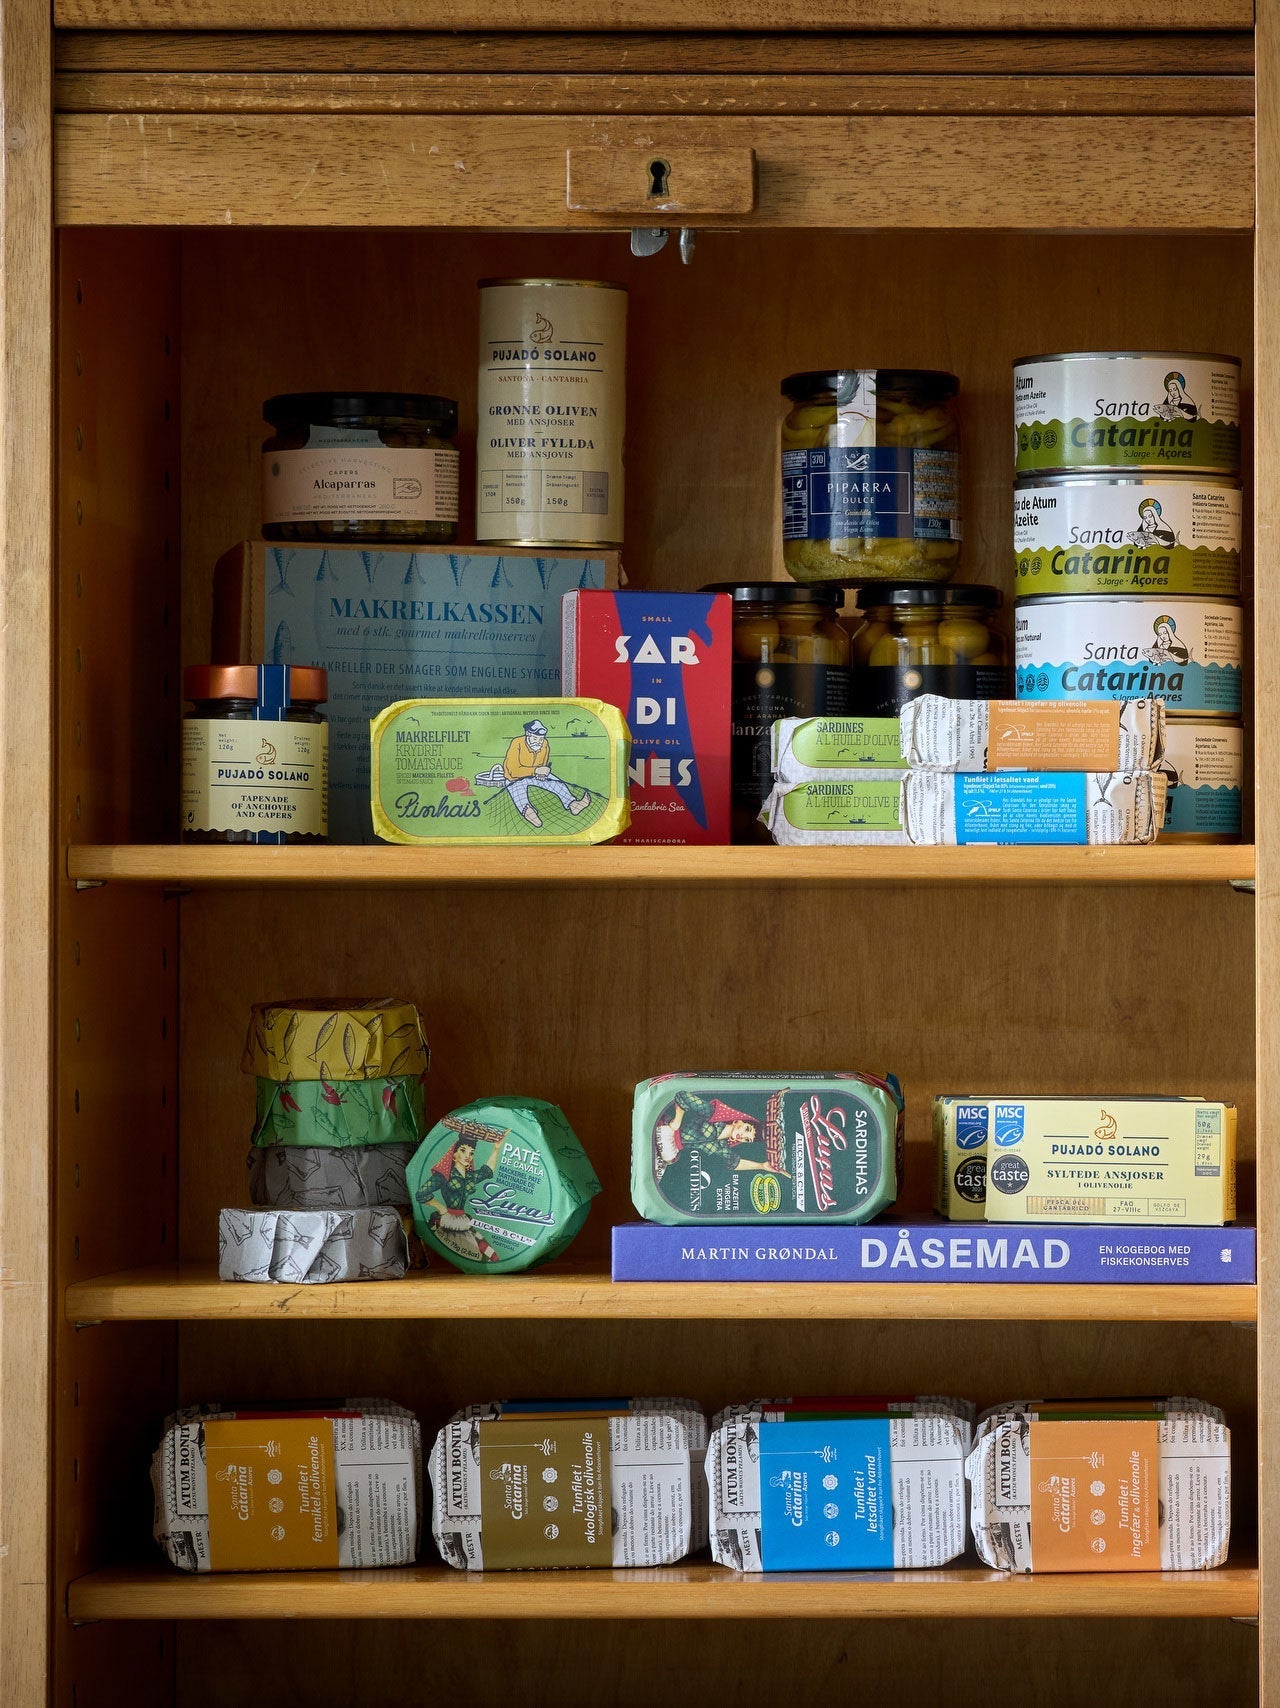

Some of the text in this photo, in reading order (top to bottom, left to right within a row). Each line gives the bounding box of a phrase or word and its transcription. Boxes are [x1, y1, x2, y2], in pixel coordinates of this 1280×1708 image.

[493, 347, 596, 362] PUJADÓ SOLANO
[489, 406, 598, 416] GRØNNE OLIVEN
[1094, 399, 1150, 416] Santa
[528, 419, 575, 427] ANSJOSER
[1071, 422, 1194, 448] Catarina
[490, 438, 594, 449] OLIVER FYLLDA
[529, 451, 573, 459] ANSJOVIS
[313, 479, 376, 491] Alcaparras
[827, 482, 891, 493] PIPARRA
[1069, 526, 1123, 544] Santa
[1051, 549, 1170, 575] Catarina
[1131, 575, 1168, 588] Açores
[329, 597, 545, 625] MAKRELKASSEN
[336, 626, 536, 642] med 6 stk. gourmet makrelkonserves
[613, 634, 700, 665] SAR
[1084, 643, 1138, 660] Santa
[1061, 666, 1184, 692] Catarina
[636, 697, 676, 725] DI
[816, 722, 864, 733] SARDINES
[396, 731, 470, 743] MAKRELFILET
[824, 734, 861, 746] L'HUILE
[863, 735, 899, 746] D'OLIVE
[396, 744, 444, 757] KRYDRET
[395, 757, 463, 770] TOMATSAUCE
[218, 767, 309, 781] PUJADÓ SOLANO
[241, 795, 288, 803] TAPENADE
[395, 792, 481, 818] Pinhais
[668, 801, 685, 812] Sea
[996, 1107, 1023, 1119] MSC
[502, 1142, 542, 1166] PATÉ
[855, 1109, 868, 1195] SARDINHAS
[1052, 1142, 1160, 1156] PUJADÓ SOLANO
[500, 1157, 544, 1177] DE CAVALA
[1000, 1161, 1020, 1171] great
[993, 1169, 1029, 1181] taste
[1047, 1170, 1164, 1181] SYLTEDE ANSJOSER
[681, 1247, 838, 1261] MARTIN GRØNDAL
[860, 1229, 1071, 1269] DÅSEMAD
[1099, 1245, 1191, 1256] EN KOGEBOG MED
[1101, 1256, 1190, 1267] FISKEKONSERVES
[309, 1436, 321, 1489] olivenolie
[181, 1472, 191, 1509] ATUM
[238, 1466, 248, 1521] Catarina
[298, 1473, 309, 1514] Tunfilet
[512, 1465, 522, 1520] Catarina
[584, 1432, 597, 1544] økologisk olivenolie
[866, 1455, 877, 1533] letsaltet vand
[792, 1472, 803, 1527] Catarina
[1060, 1477, 1071, 1533] Catarina
[1130, 1450, 1142, 1558] ingefær olivenolie
[311, 1496, 322, 1544] fennikel
